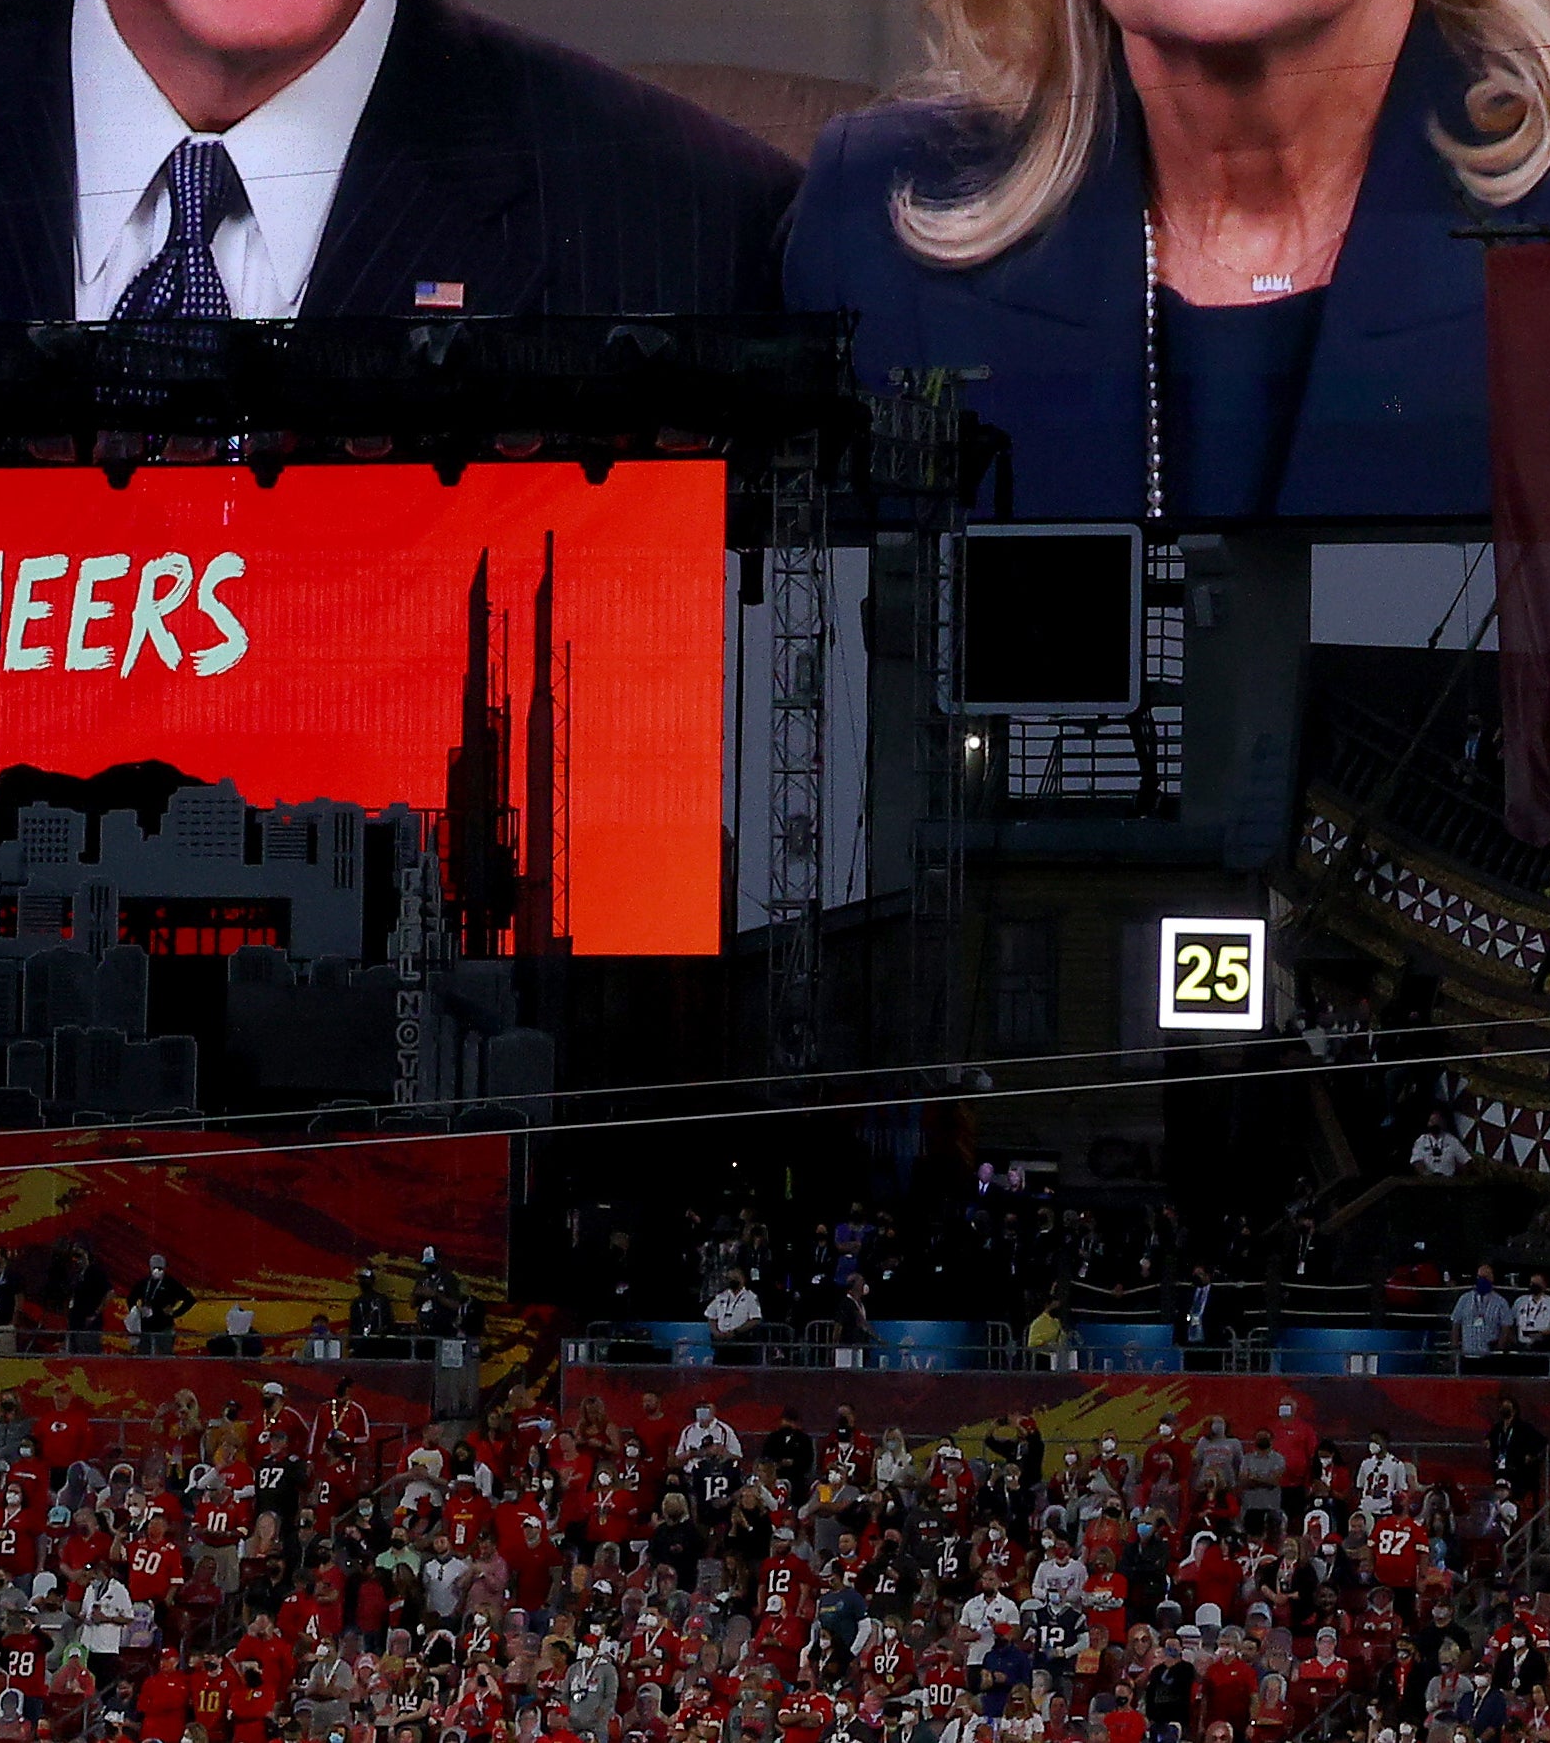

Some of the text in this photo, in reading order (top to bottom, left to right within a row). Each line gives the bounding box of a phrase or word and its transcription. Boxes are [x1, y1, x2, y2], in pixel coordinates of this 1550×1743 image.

[1176, 944, 1251, 1003] 25
[704, 1476, 728, 1501] 12
[1379, 1530, 1410, 1555] 87
[132, 1549, 161, 1575] 50
[938, 1556, 958, 1578] 12
[768, 1570, 790, 1593] 12
[875, 1574, 896, 1593] 12
[9, 1651, 34, 1676] 28
[875, 1654, 899, 1674] 87
[198, 1690, 220, 1712] 10
[929, 1684, 952, 1705] 90
